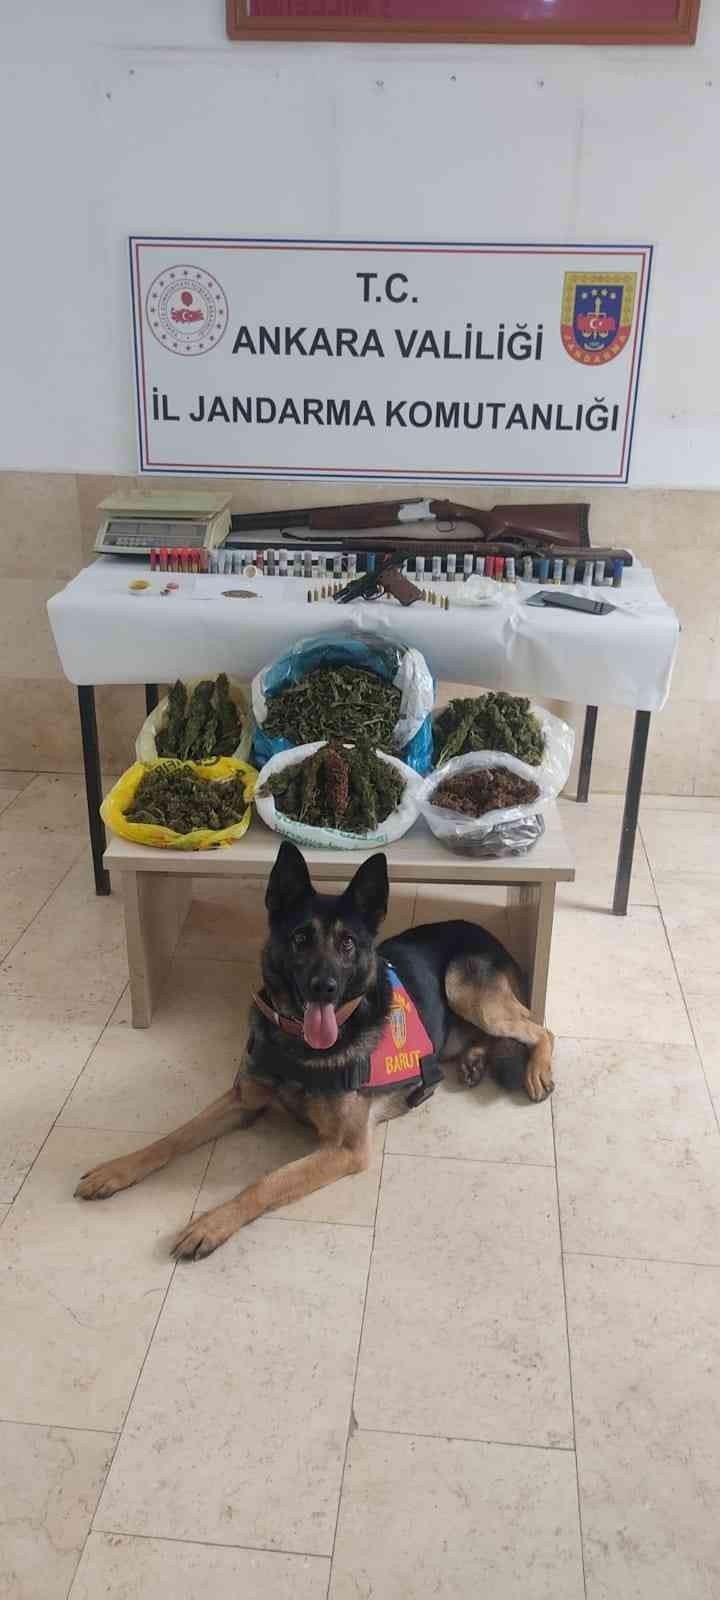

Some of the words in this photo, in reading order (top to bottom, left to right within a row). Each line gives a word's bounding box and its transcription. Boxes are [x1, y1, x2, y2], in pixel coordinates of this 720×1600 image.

[356, 272, 418, 304] T.C.
[231, 325, 386, 358] ANKARA
[394, 322, 544, 361] VALİLİĞİ
[152, 387, 181, 422] İL
[189, 395, 376, 427] JANDARMA
[385, 395, 619, 432] KOMUTANLIĞI
[384, 1049, 420, 1075] BARUT
